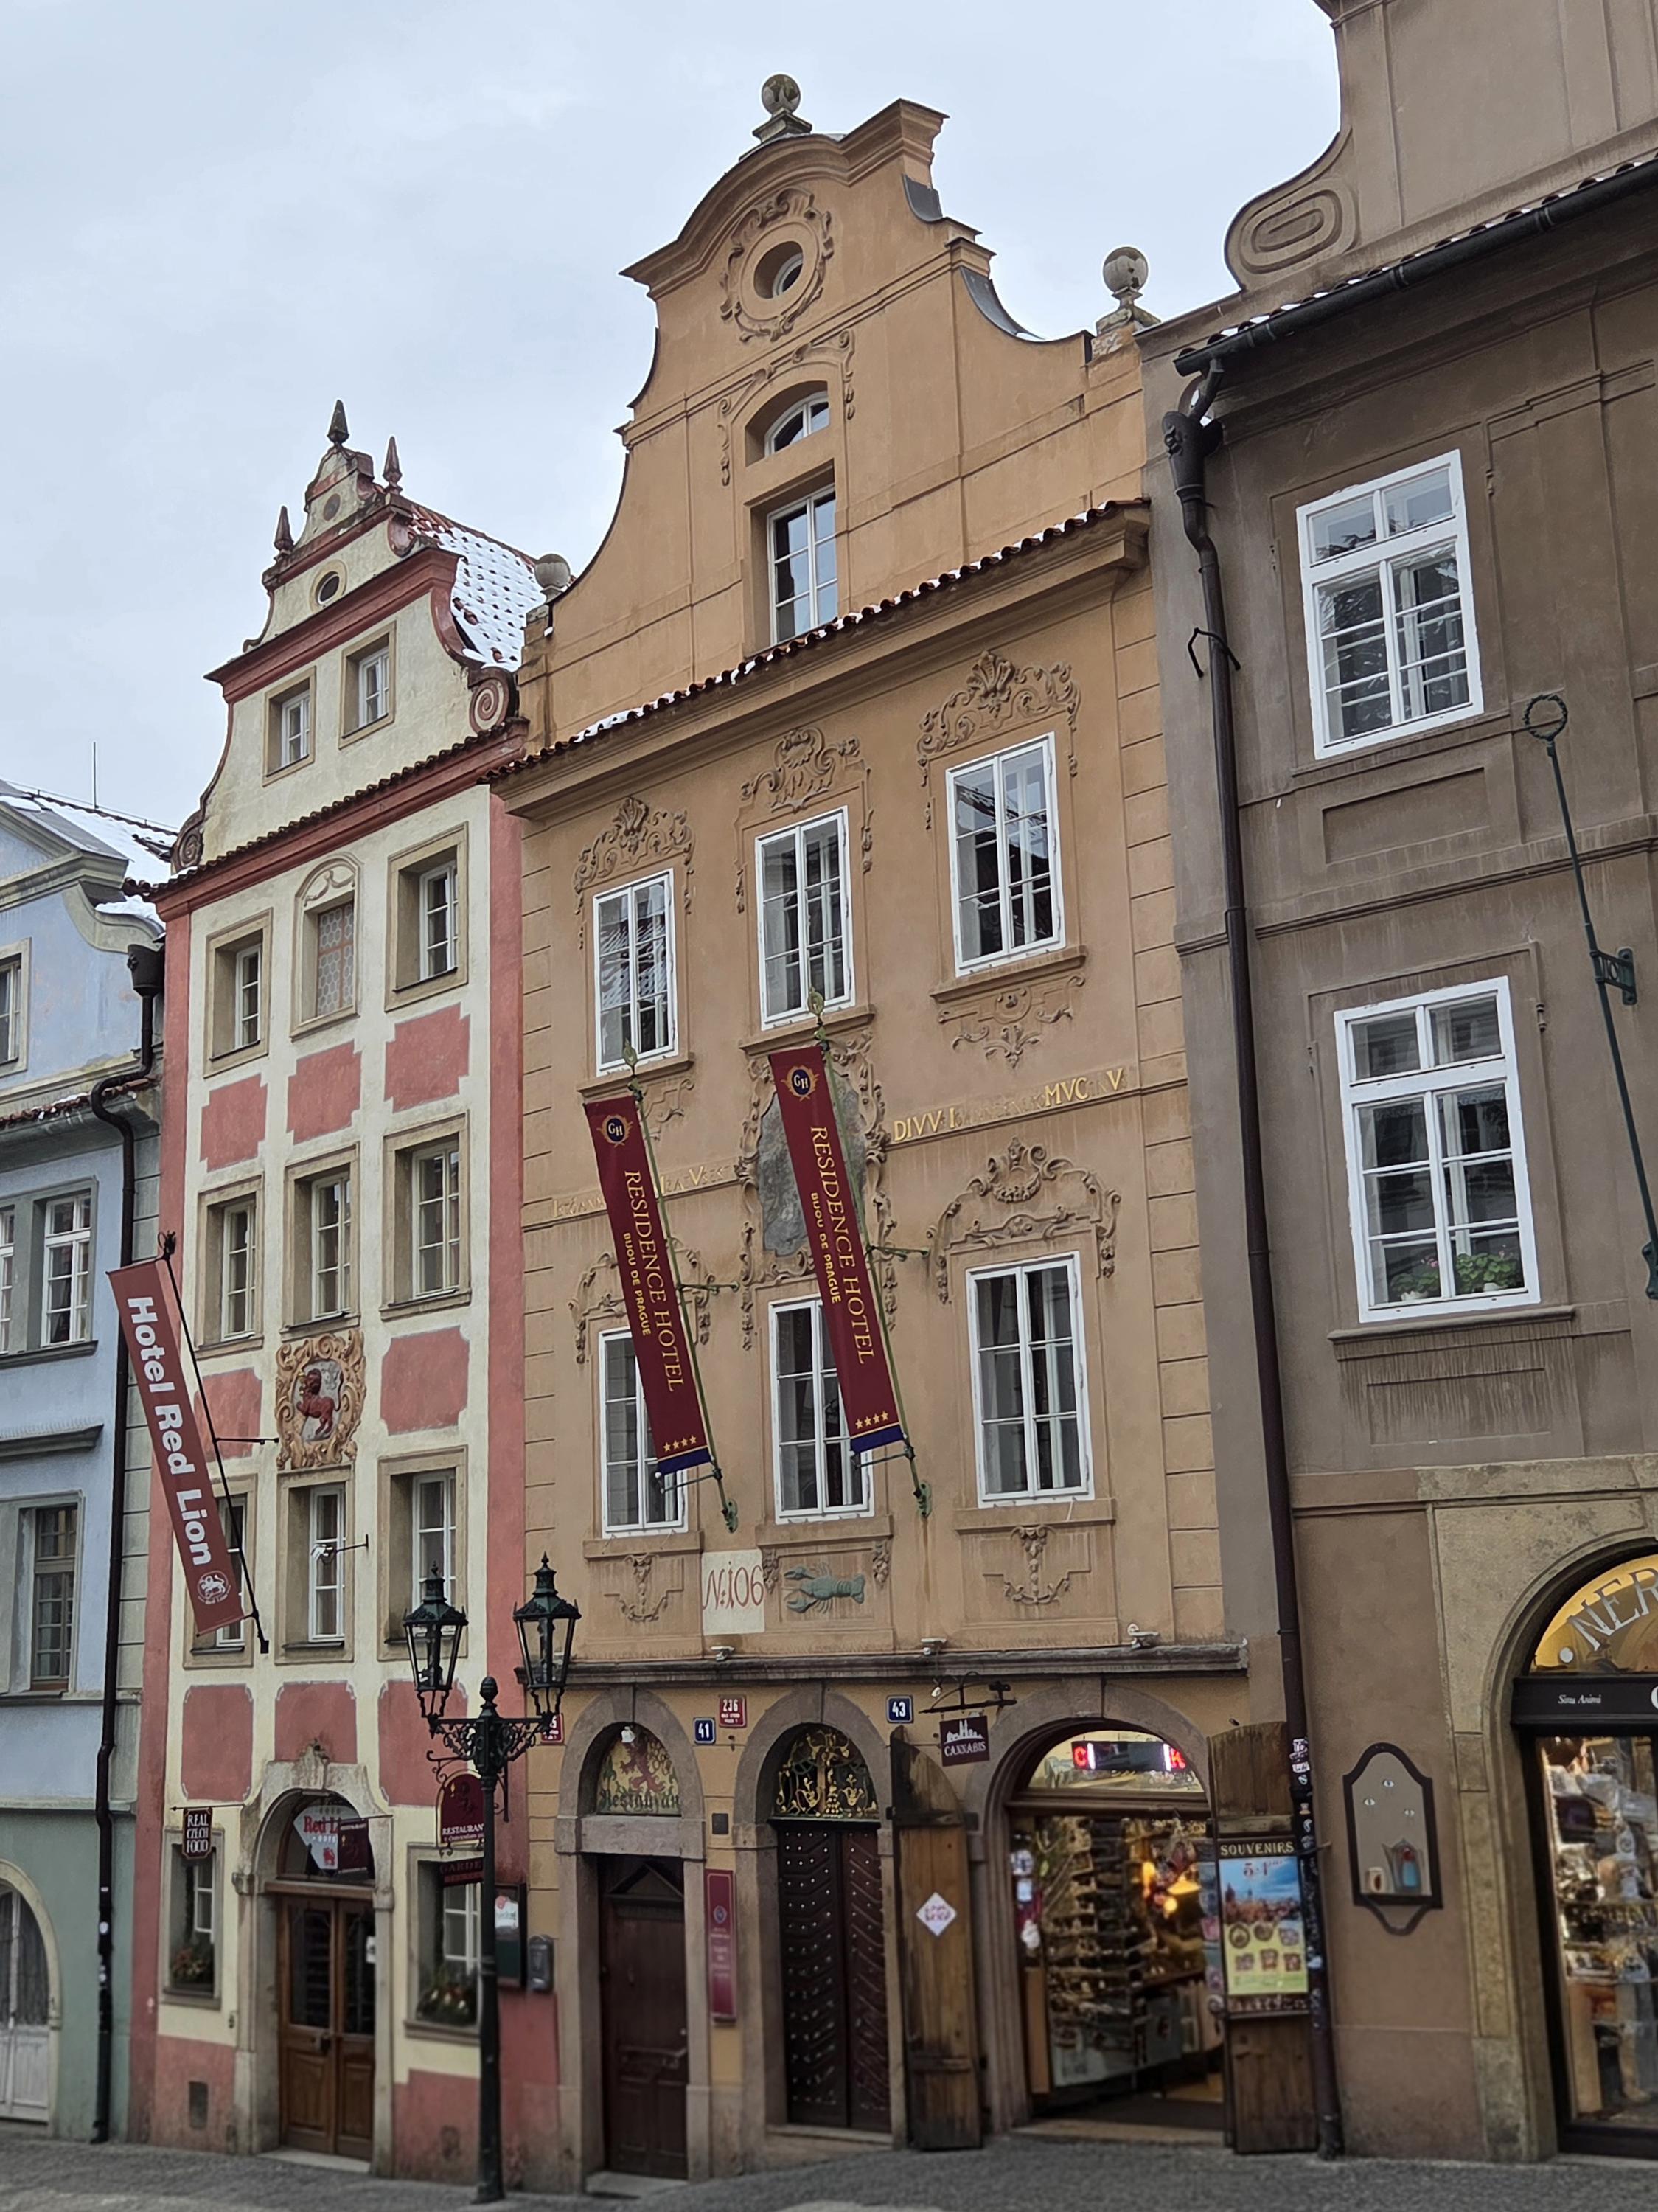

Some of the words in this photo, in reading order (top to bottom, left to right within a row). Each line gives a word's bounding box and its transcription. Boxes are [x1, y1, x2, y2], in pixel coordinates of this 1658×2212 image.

[810, 1192, 825, 1229] BIJOU
[622, 1232, 636, 1268] BIJOU
[811, 1125, 854, 1269] RESIDENCE
[843, 1277, 874, 1365] HOTEL
[818, 1232, 829, 1251] DE
[624, 1169, 667, 1304] RESIDENCE
[653, 1310, 684, 1392] HOTEL
[632, 1270, 641, 1286] DE
[823, 1253, 841, 1304] PRAGUE
[635, 1289, 652, 1337] PRAGUE
[126, 1296, 176, 1393] Hotel
[153, 1404, 195, 1475] Red
[175, 1489, 213, 1566] Lion
[722, 1698, 739, 1712] 236
[891, 1701, 907, 1718] 43
[698, 1722, 710, 1739] 41
[944, 1741, 986, 1757] CANNABIS
[187, 1814, 209, 1827] REAL
[303, 1815, 326, 1834] Red
[186, 1827, 209, 1839] CZECH
[442, 1823, 484, 1836] RESTAURAN
[186, 1839, 209, 1853] FOOD
[1220, 1841, 1295, 1857] SOUVENIRS
[439, 1860, 482, 1874] GARDE
